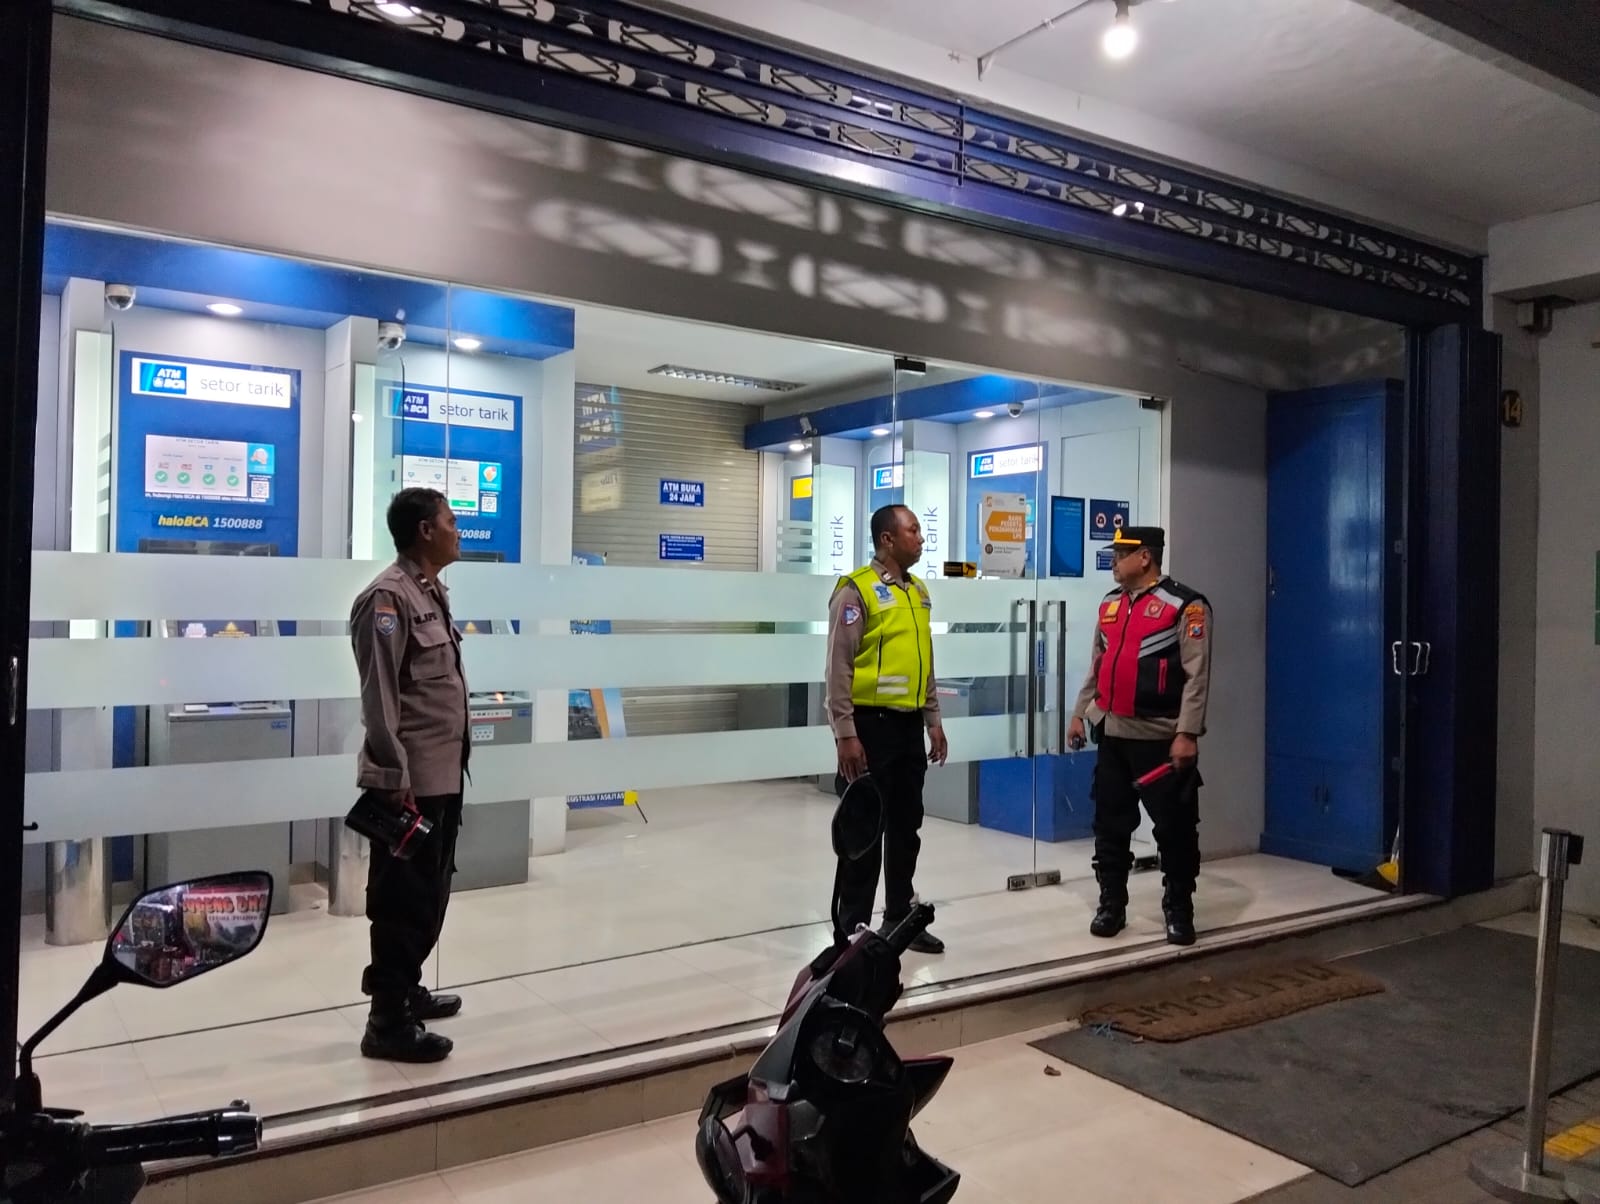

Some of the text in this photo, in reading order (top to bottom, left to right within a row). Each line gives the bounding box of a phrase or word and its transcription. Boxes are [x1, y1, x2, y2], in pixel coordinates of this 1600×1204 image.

[157, 368, 181, 379] ATM
[164, 379, 185, 390] BCA
[200, 377, 284, 397] setor tarik
[405, 395, 424, 404] ATM
[410, 404, 427, 414] BCA
[440, 404, 508, 421] setor tarik
[1503, 395, 1521, 423] 14
[663, 482, 702, 494] ATM BUKA
[669, 493, 696, 502] 24 JAM
[158, 514, 263, 529] haloBCA 1500888
[924, 506, 938, 552] tarik
[830, 515, 844, 557] tarik
